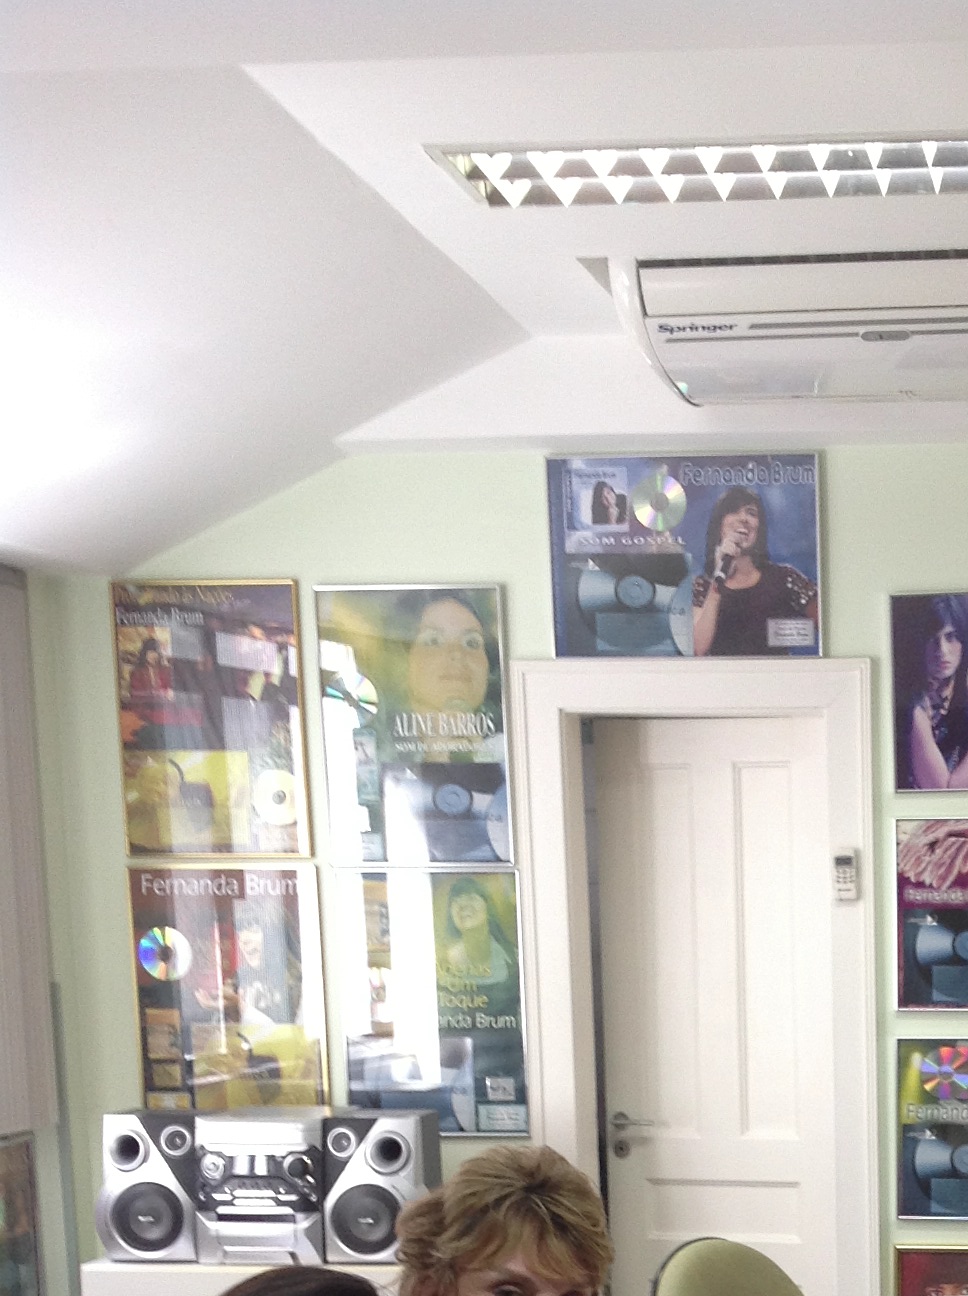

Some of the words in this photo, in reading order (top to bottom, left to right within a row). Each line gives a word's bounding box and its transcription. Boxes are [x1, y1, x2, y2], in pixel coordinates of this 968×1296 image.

[657, 321, 738, 335] Springer
[679, 462, 769, 486] Fernanda
[770, 461, 816, 485] Brum
[579, 535, 616, 546] SOM
[393, 712, 437, 737] ALINE
[439, 712, 496, 738] BARROS
[140, 873, 240, 897] Fernanda
[245, 873, 299, 896] Brum
[475, 1012, 517, 1029] Brum
